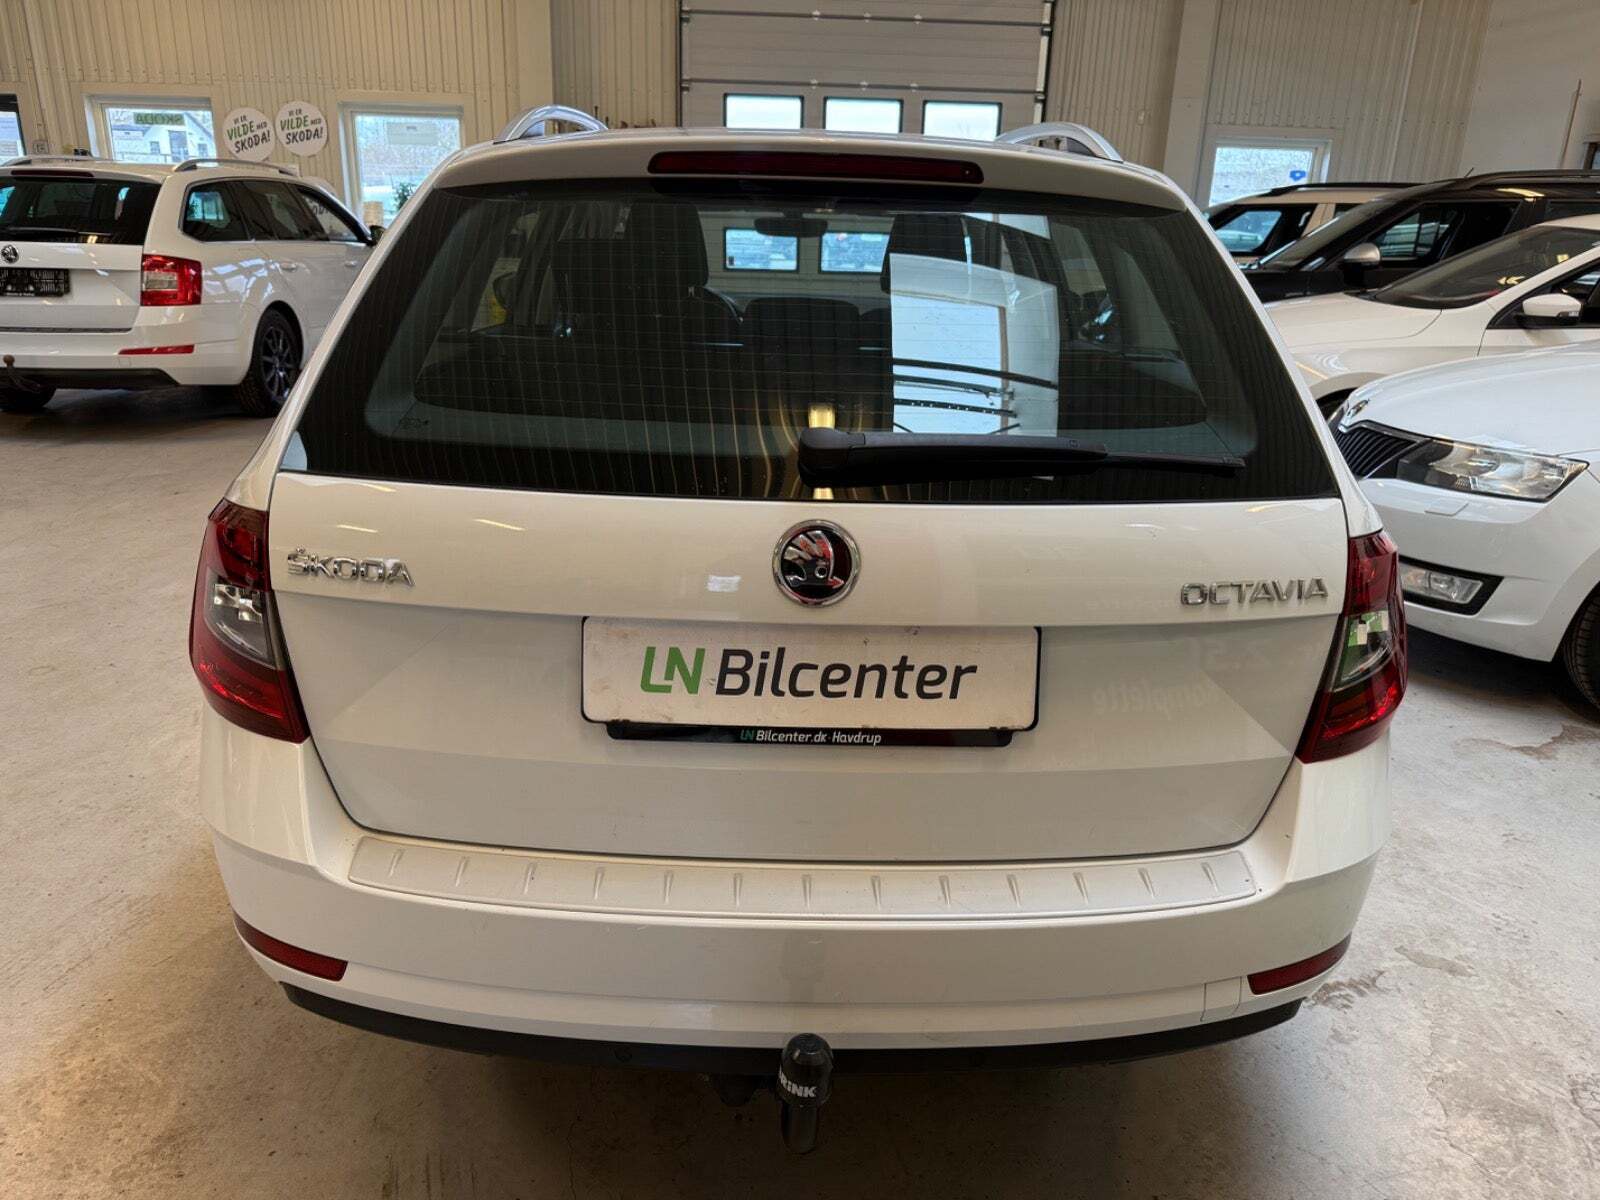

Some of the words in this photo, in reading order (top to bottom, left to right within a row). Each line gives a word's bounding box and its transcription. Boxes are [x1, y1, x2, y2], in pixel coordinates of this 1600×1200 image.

[227, 120, 255, 141] VILDE
[280, 115, 309, 132] VILDE
[234, 130, 271, 153] SKODA!
[286, 127, 324, 145] SKODA!
[287, 546, 415, 586] ŠKODA
[1180, 577, 1329, 606] OCTAVIA
[640, 646, 706, 694] LN
[715, 647, 978, 700] Bilcenter
[755, 730, 827, 743] Bilcenter.dk
[831, 731, 882, 746] Havdrup
